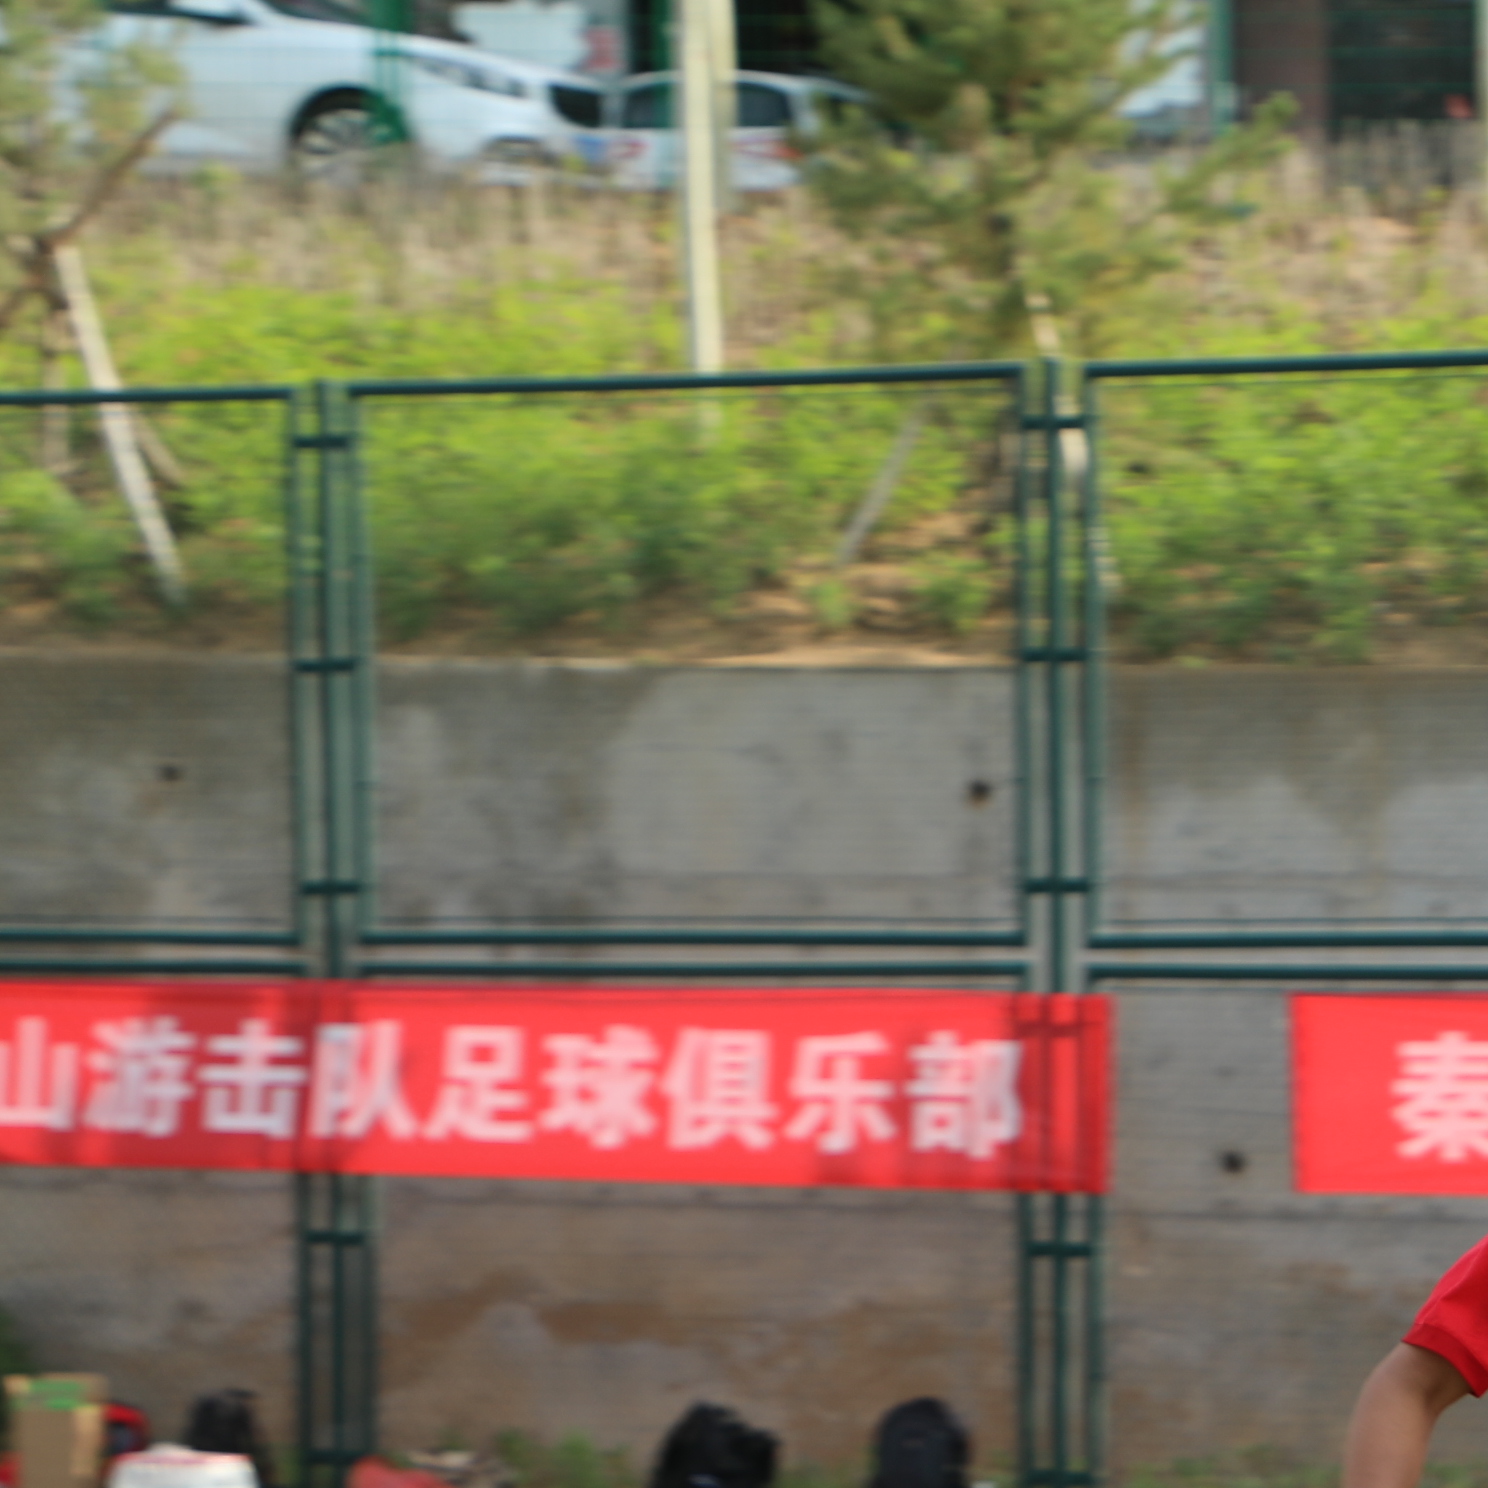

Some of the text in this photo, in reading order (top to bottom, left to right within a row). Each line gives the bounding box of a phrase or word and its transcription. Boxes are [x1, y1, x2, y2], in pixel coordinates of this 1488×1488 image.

[0, 1014, 1024, 1160] 山游击队足球俱乐部
